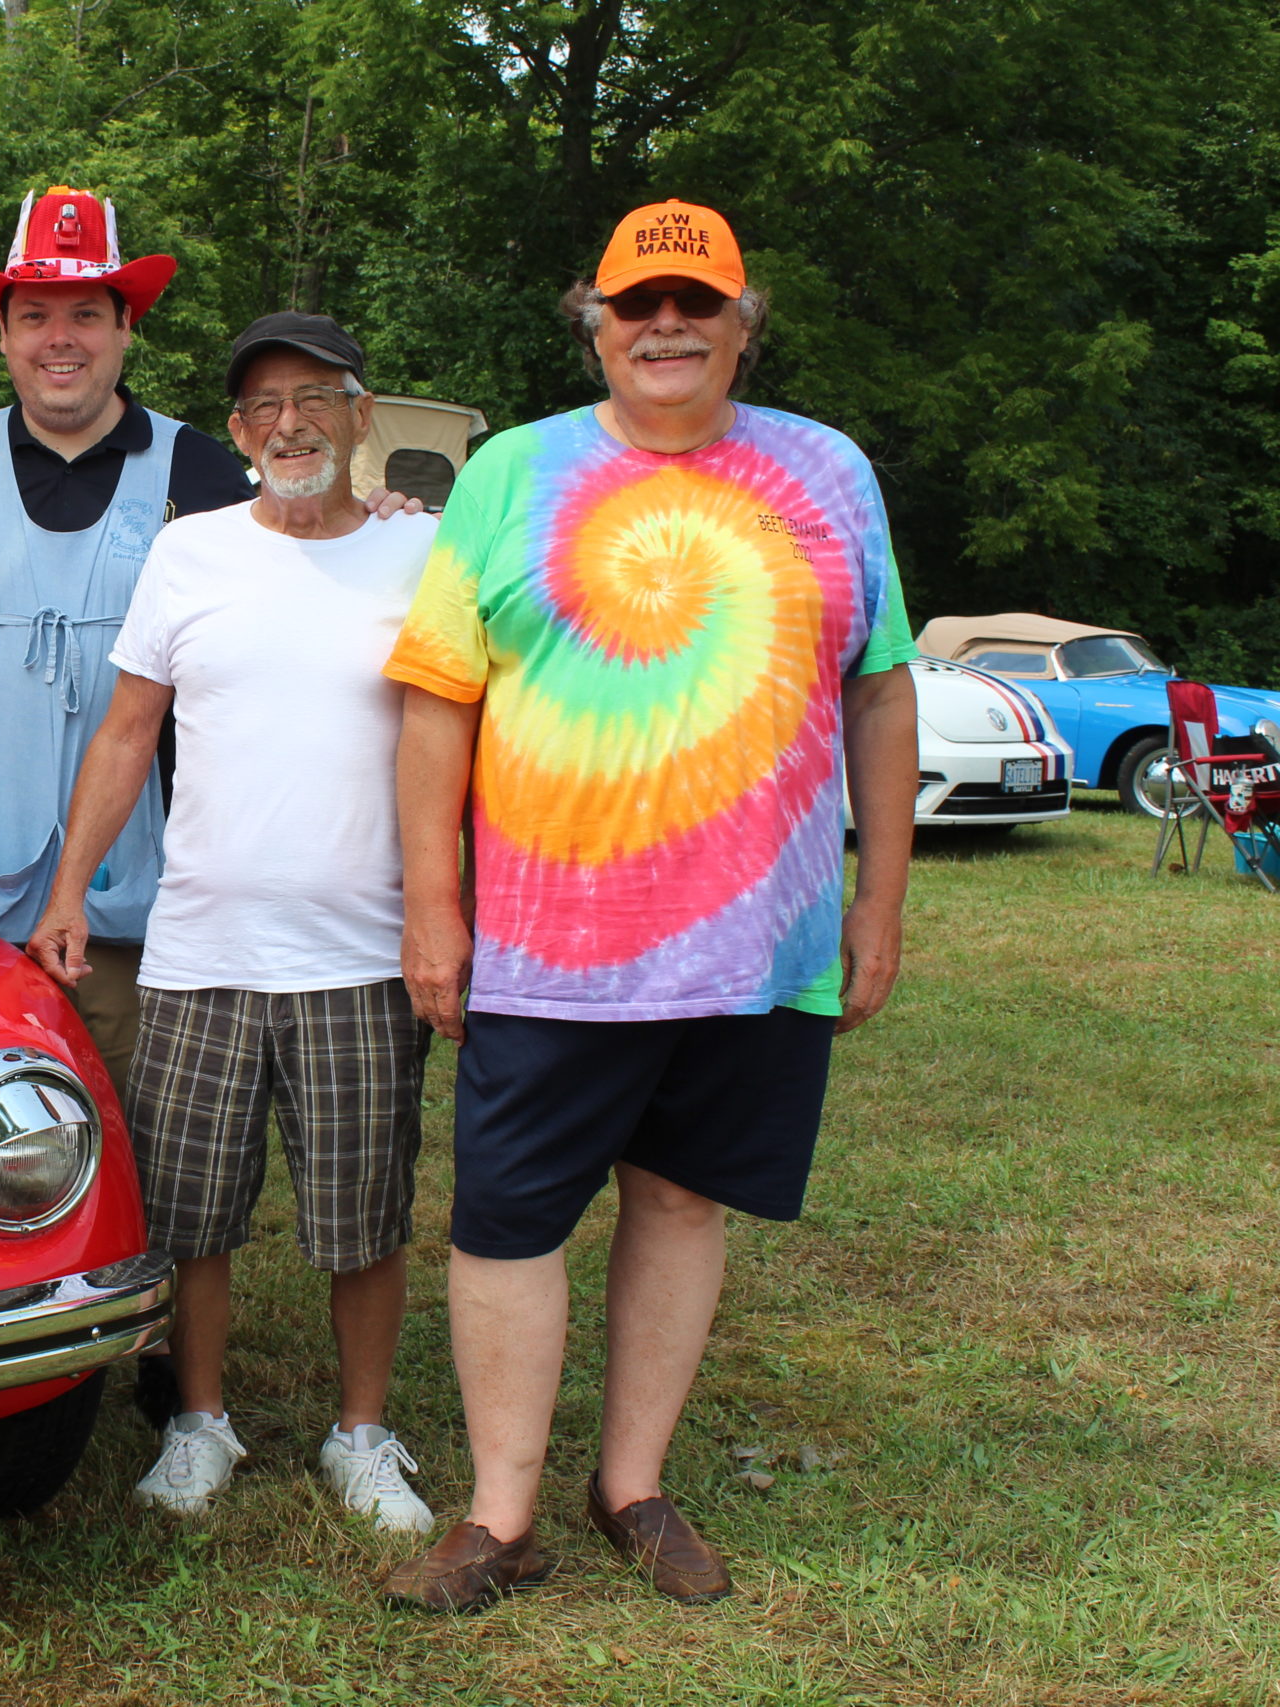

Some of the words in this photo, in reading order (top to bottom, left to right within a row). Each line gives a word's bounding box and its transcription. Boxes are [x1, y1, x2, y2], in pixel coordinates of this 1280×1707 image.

[635, 226, 710, 244] BEETLE
[636, 241, 710, 259] MANIA
[757, 513, 830, 544] BEETLEMANIA
